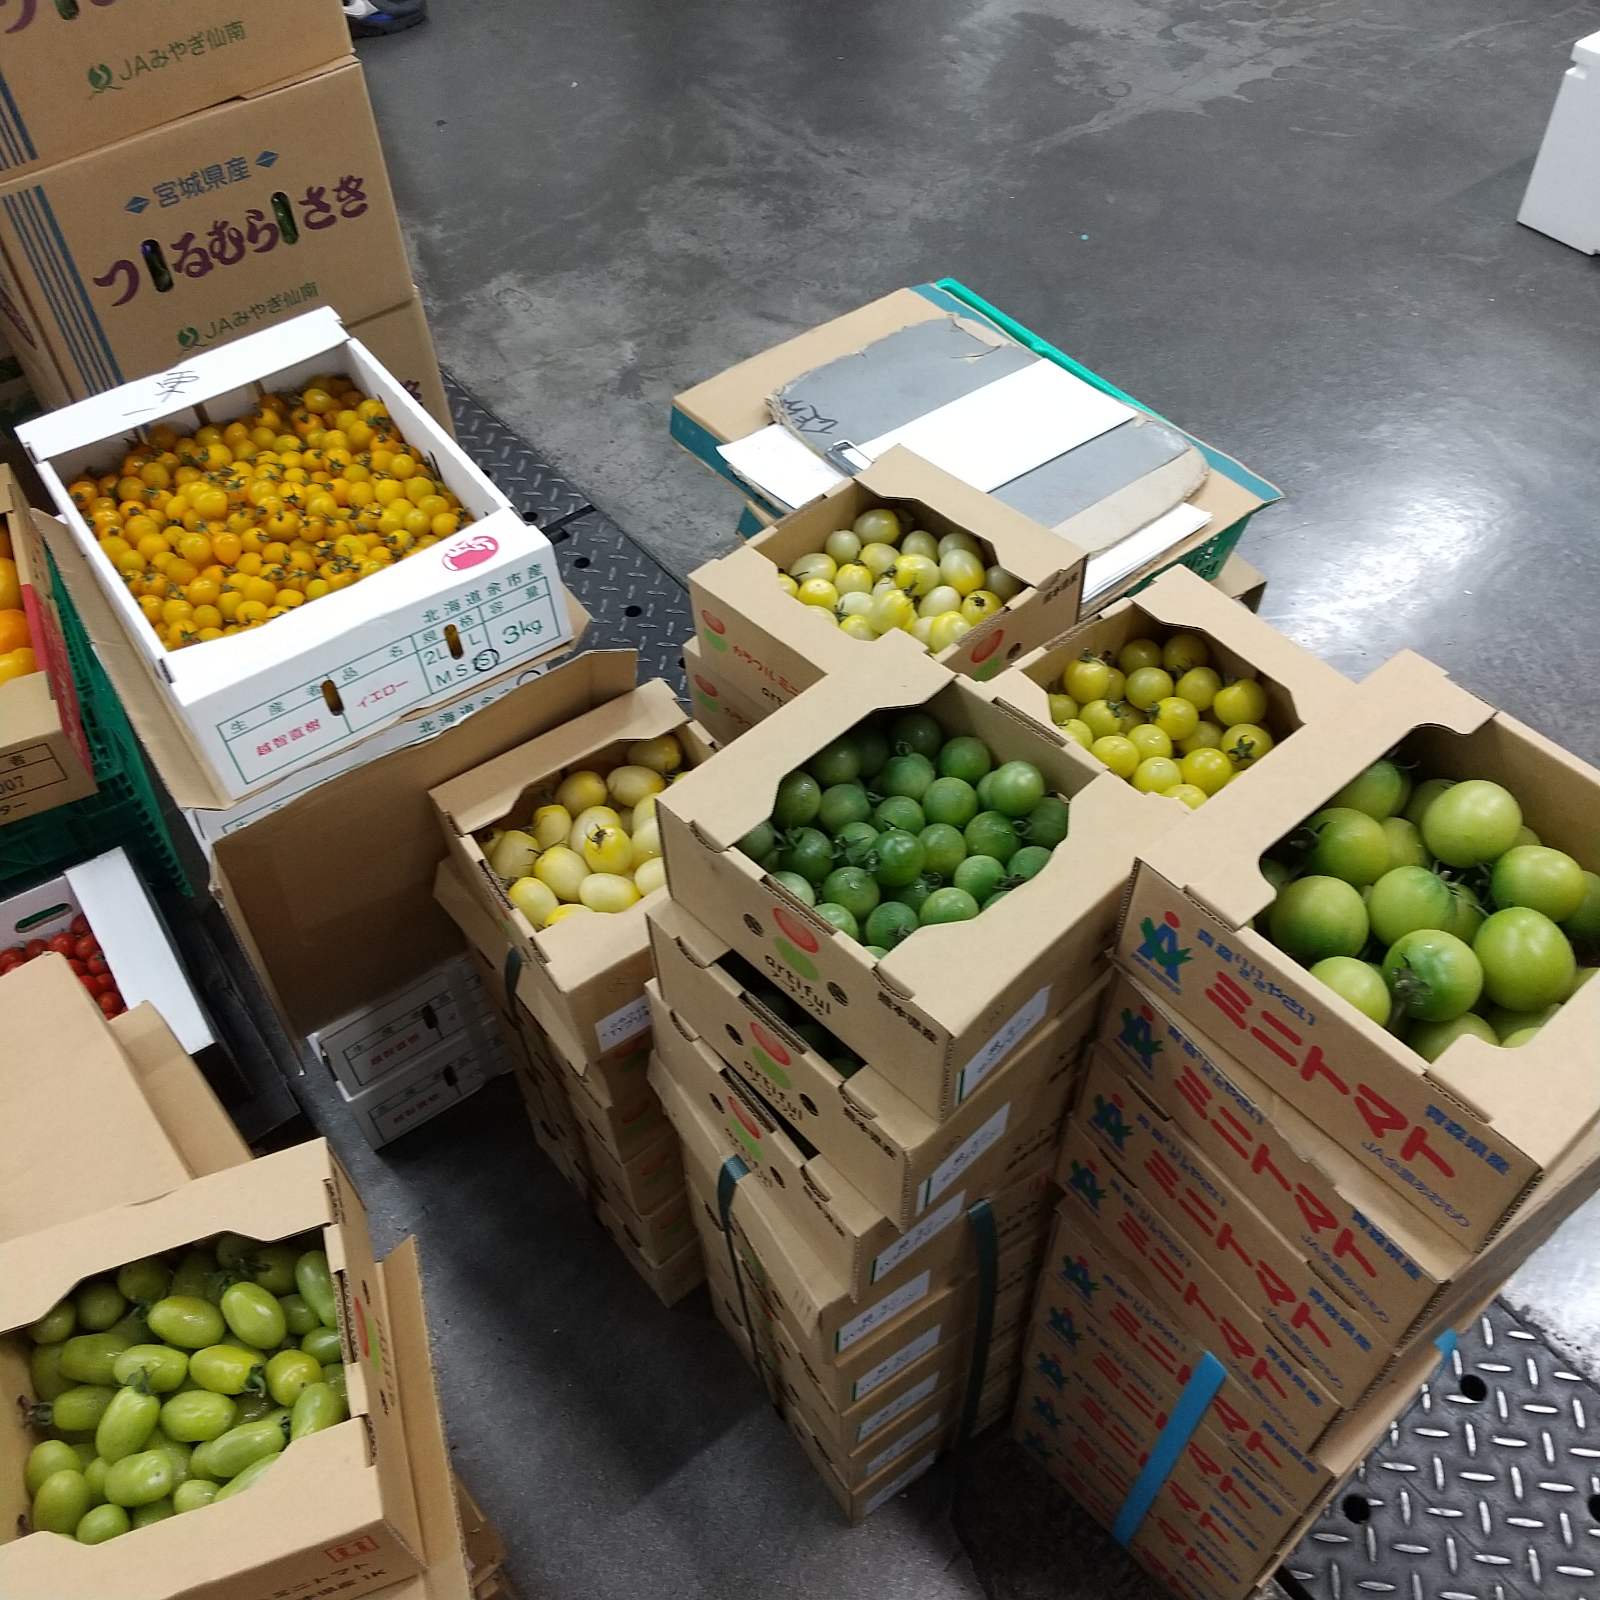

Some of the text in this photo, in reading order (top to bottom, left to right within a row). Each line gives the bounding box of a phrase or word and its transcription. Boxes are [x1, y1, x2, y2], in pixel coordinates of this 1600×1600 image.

[119, 20, 246, 82] JAみやぎ仙南
[152, 155, 252, 209] 宮城県産
[93, 175, 369, 307] つるむらさき
[204, 281, 319, 341] JAみやぎ仙南
[423, 648, 448, 666] 2L
[502, 619, 544, 645] 3kg
[342, 645, 404, 682] 品名
[435, 670, 452, 686] M
[455, 663, 469, 677] S
[356, 680, 409, 708] イエロー
[1205, 971, 1456, 1179] ミニトマト
[1174, 1064, 1377, 1278] ミニトマト
[1144, 1150, 1332, 1349] ミニトマト
[1117, 1211, 1289, 1400] ミニトマト
